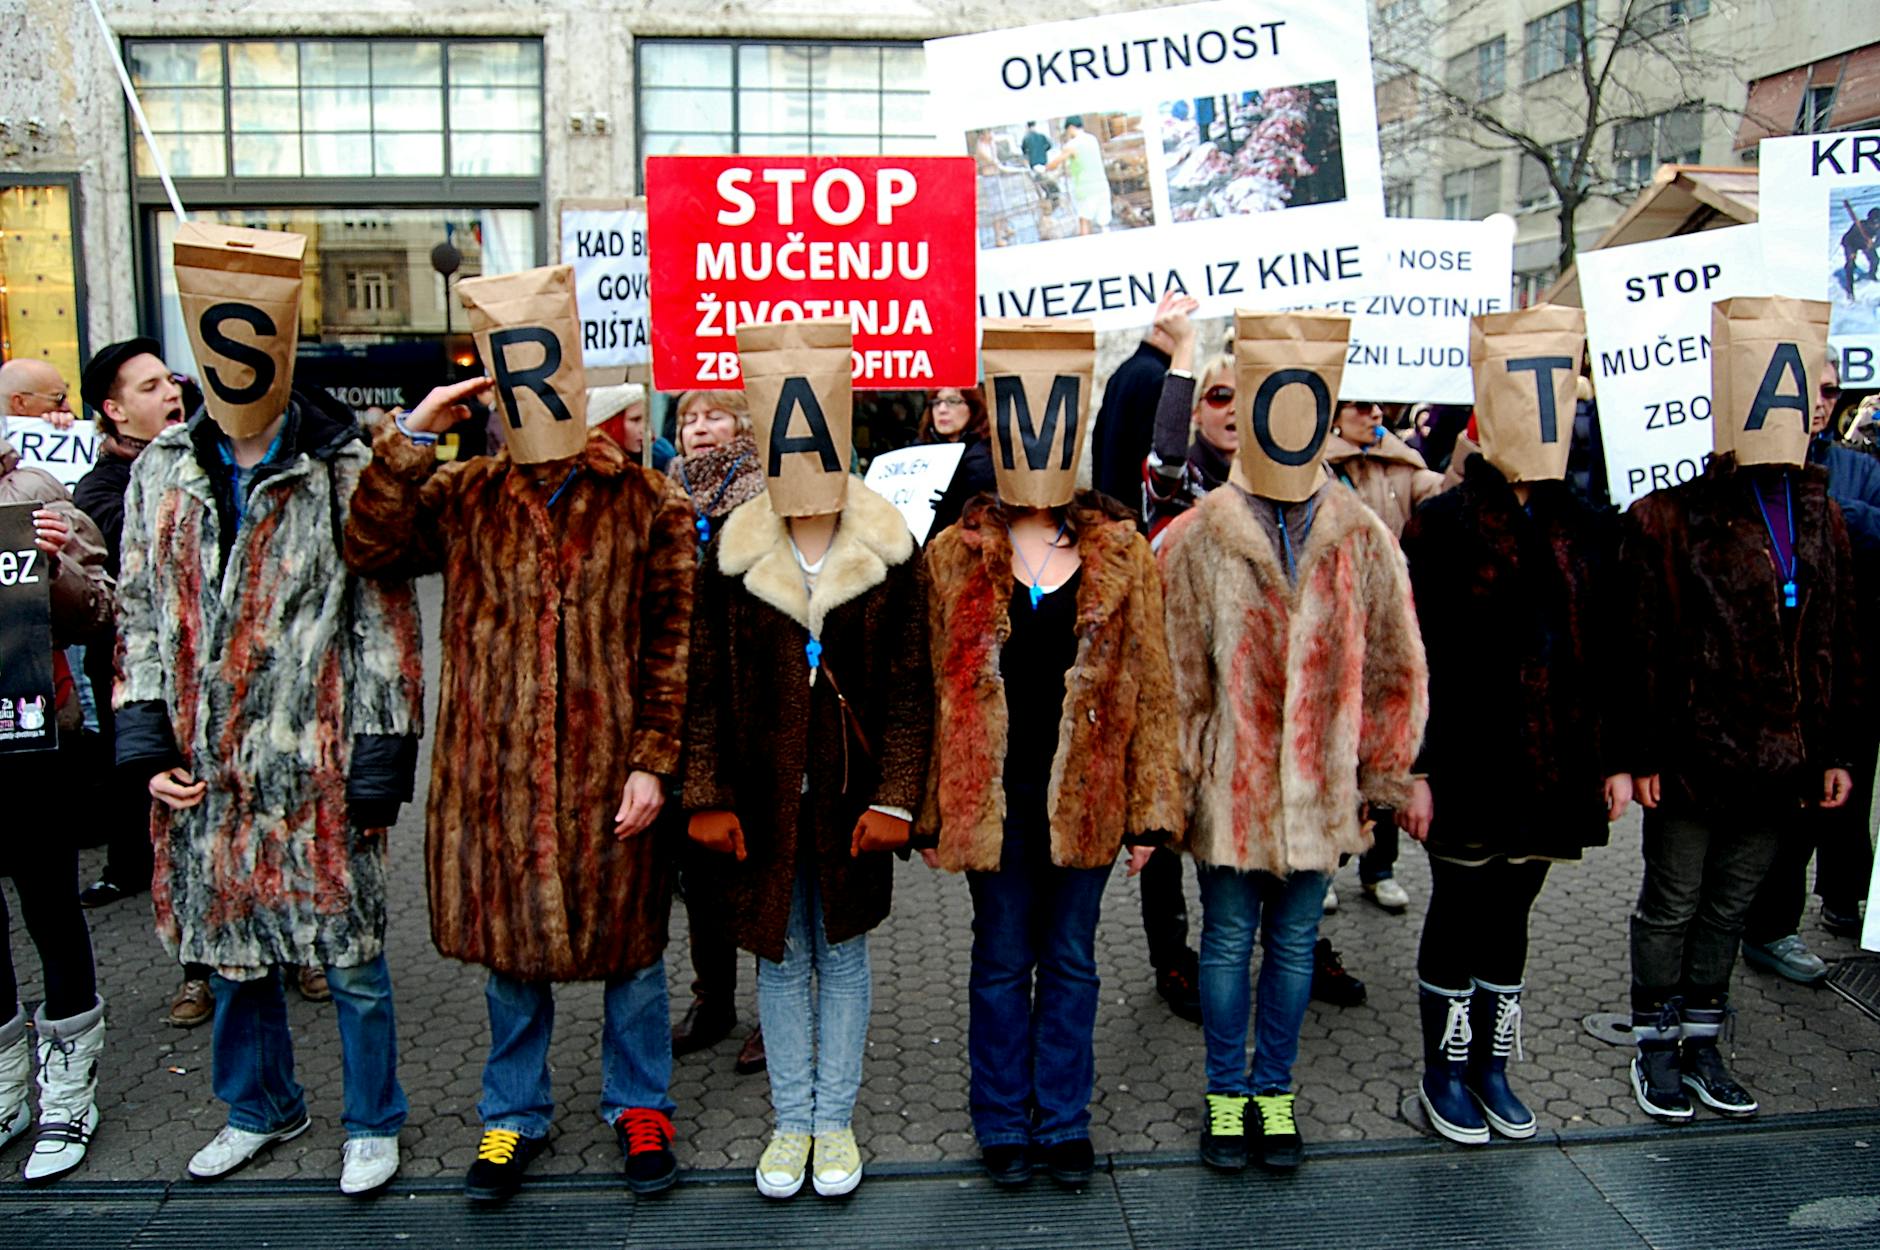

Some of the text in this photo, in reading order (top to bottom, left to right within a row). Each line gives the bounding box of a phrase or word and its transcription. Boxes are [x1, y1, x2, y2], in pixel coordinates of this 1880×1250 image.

[1001, 21, 1287, 91] OKRUTNOST
[716, 167, 918, 227] STOP
[577, 230, 624, 258] KAD
[695, 232, 930, 282] MUČENJU
[1205, 261, 1244, 297] IZ
[1258, 245, 1363, 290] KINE
[1399, 249, 1472, 272] NOSE
[1625, 263, 1722, 303] STOP
[579, 310, 651, 350] RIŠTA
[695, 292, 934, 337] ŽIVOTINJA
[200, 302, 278, 406] S
[489, 327, 573, 429] R
[1842, 347, 1876, 383] B
[1506, 356, 1574, 444] T
[1643, 395, 1712, 431] ZBO
[1744, 343, 1810, 434] A
[768, 376, 843, 478] A
[993, 375, 1081, 471] M
[1252, 368, 1332, 466] O
